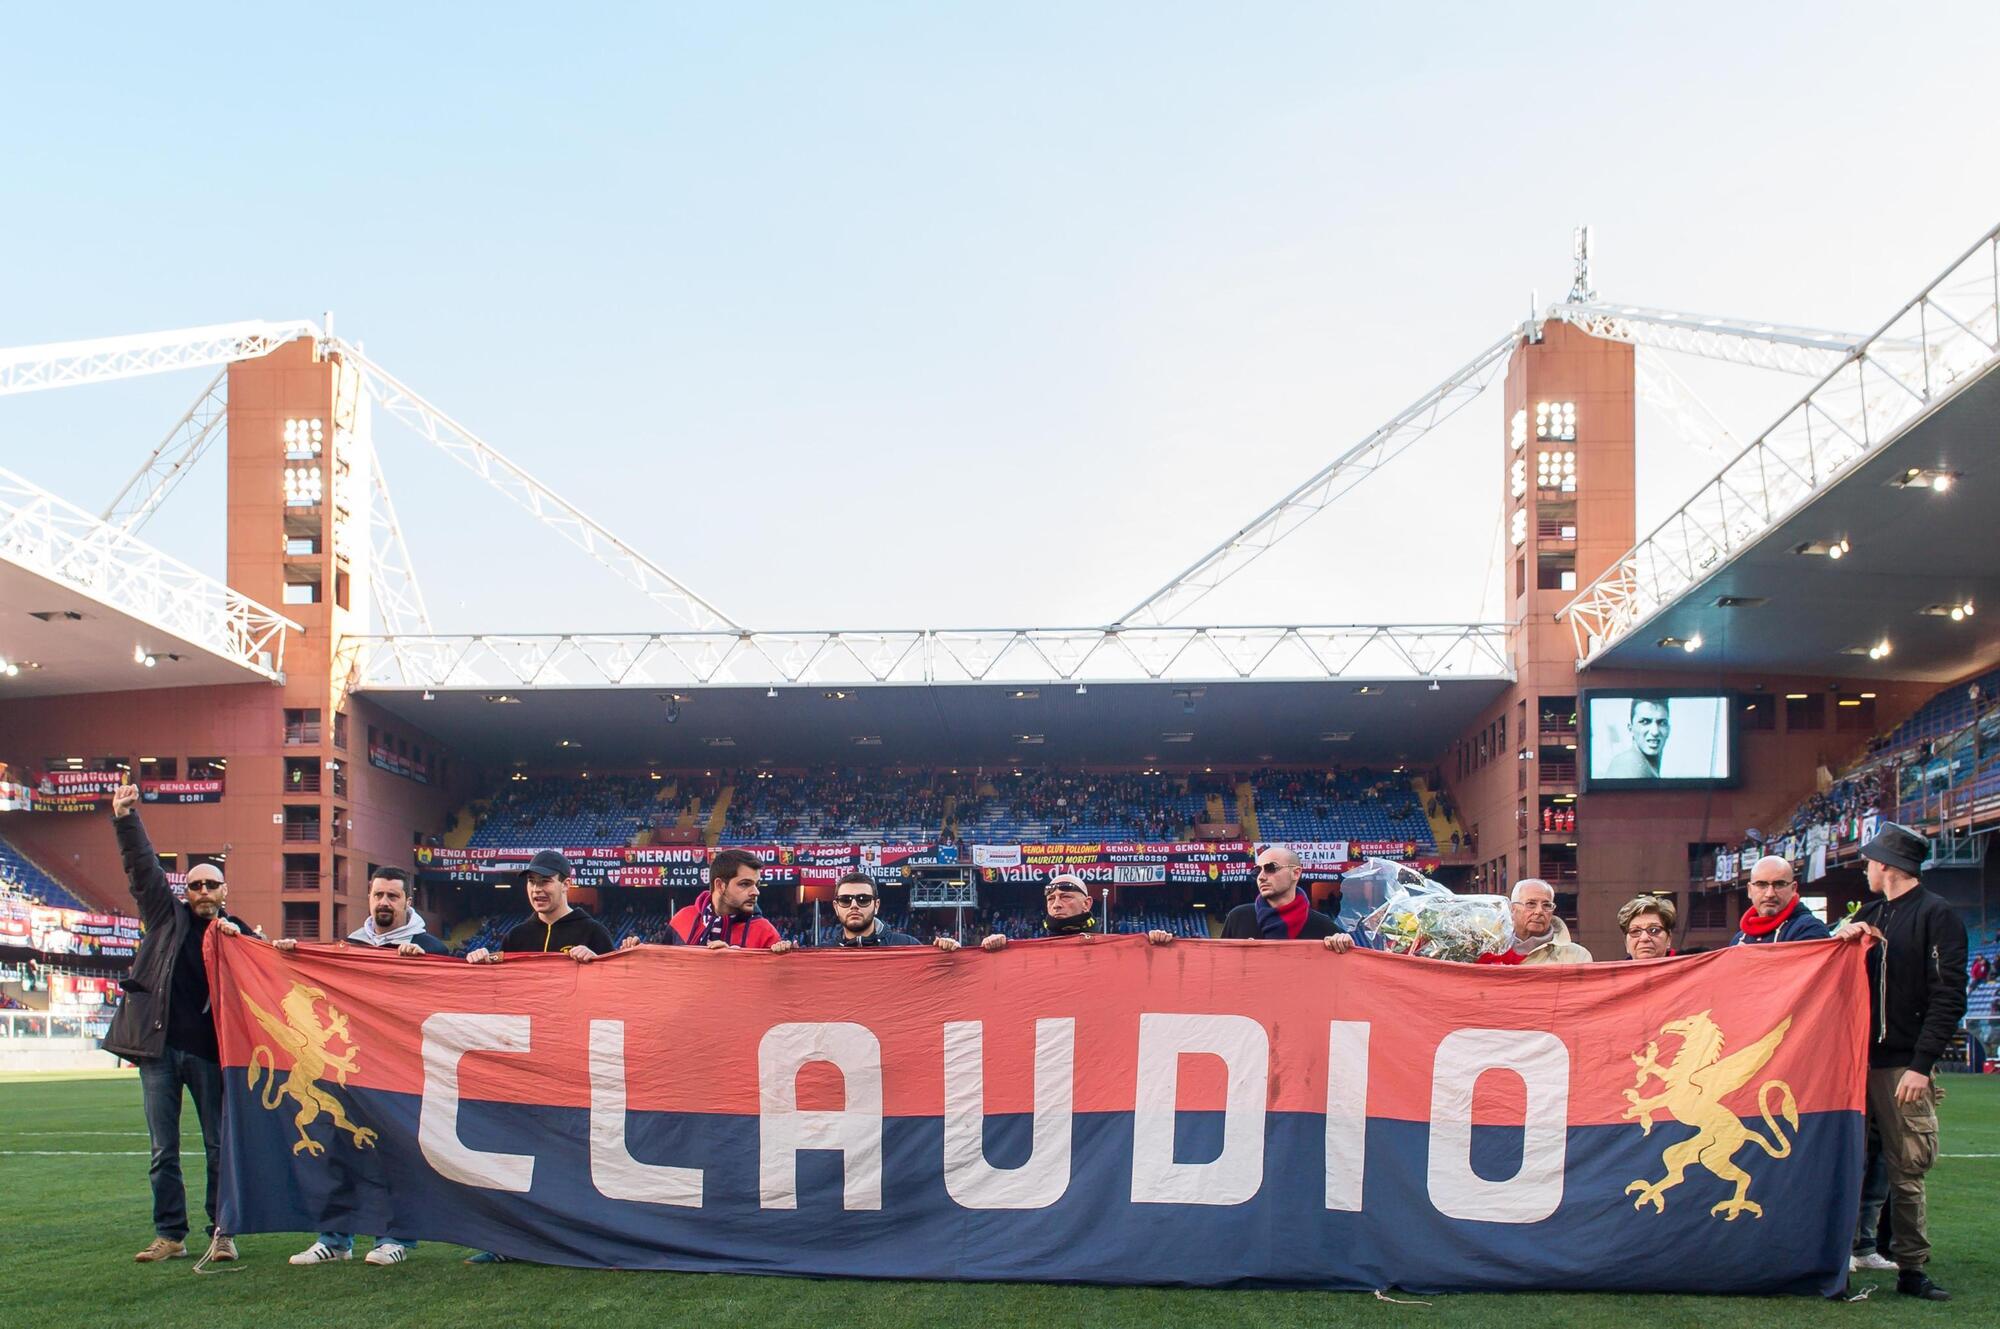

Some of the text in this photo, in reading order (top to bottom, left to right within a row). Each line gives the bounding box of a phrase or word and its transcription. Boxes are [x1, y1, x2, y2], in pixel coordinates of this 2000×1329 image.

[58, 784, 100, 795] RAPALLO
[193, 783, 219, 791] CLUB
[179, 794, 204, 802] SORI
[57, 804, 95, 812] CASOTTO
[816, 847, 852, 856] HONG
[1022, 845, 1045, 854] GENOA
[1046, 845, 1065, 854] CLUB
[1065, 844, 1101, 854] FOLLONICA
[1105, 845, 1170, 853] GENOA CLUB
[1175, 842, 1244, 852] GENOA CLUB
[433, 848, 496, 859] GENOA CLUB
[592, 848, 613, 858] ASTI
[637, 849, 692, 863] MERANO
[1296, 851, 1336, 860] CEANIA
[815, 856, 851, 866] KONG
[907, 857, 938, 865] ALASKA
[1026, 855, 1063, 865] MAURIZIO
[1064, 854, 1098, 864] MORETTI
[1110, 854, 1168, 862] MONTEROSSO
[1187, 854, 1229, 862] LEVANTO
[1174, 862, 1200, 870] GENOA
[1314, 863, 1342, 871] MASONE
[580, 868, 605, 876] CLUB
[620, 867, 699, 875] GENOA CLUB
[1000, 864, 1046, 882] Valle
[1118, 866, 1153, 882] TRENTO
[1170, 868, 1251, 876] CASARZA LIGURE
[450, 871, 485, 882] PEGLI
[1172, 874, 1247, 883] MAURIZIO SIVORI
[624, 877, 698, 886] MONTECARLO
[418, 1012, 1570, 1223] CLAUDIO
